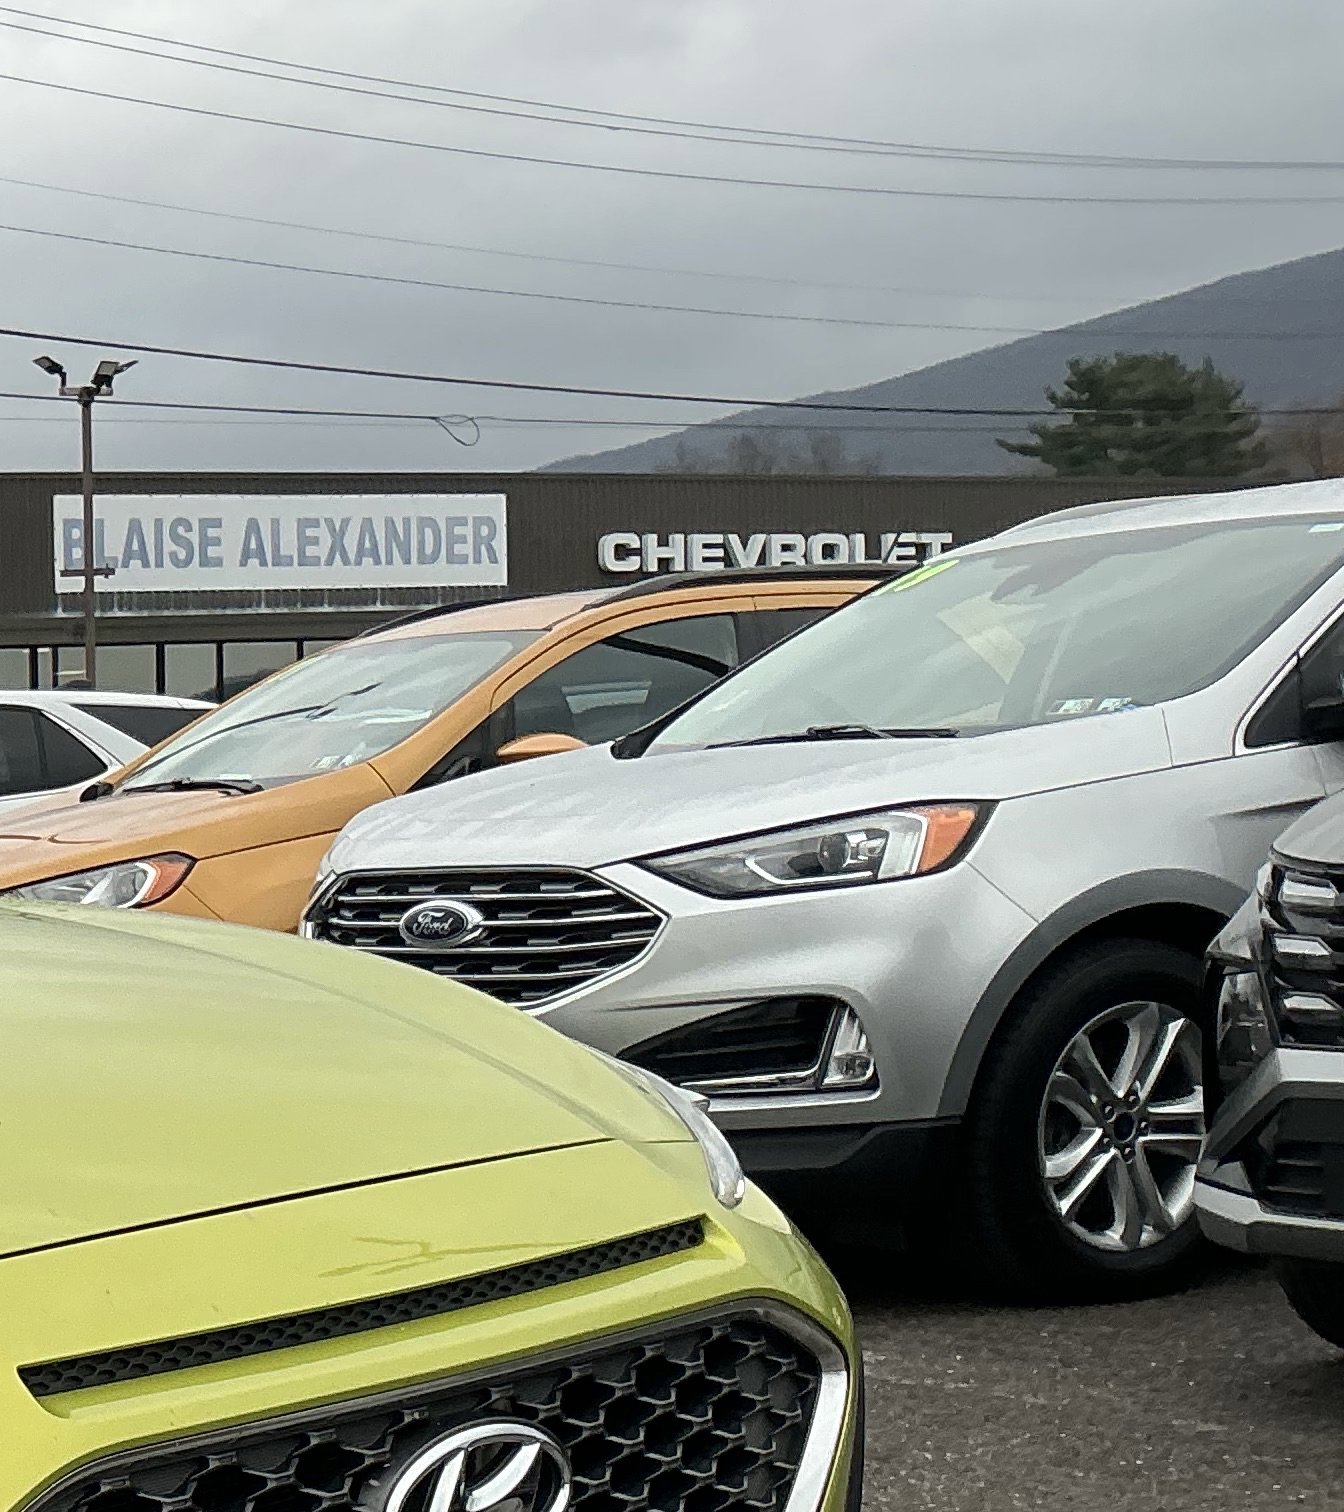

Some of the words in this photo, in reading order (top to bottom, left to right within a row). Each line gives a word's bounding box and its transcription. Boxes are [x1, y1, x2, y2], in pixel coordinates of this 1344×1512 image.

[62, 518, 223, 570] BLAISE
[239, 516, 499, 567] ALEXANDER
[598, 532, 953, 572] CHEVROLET
[412, 911, 454, 936] Ford
